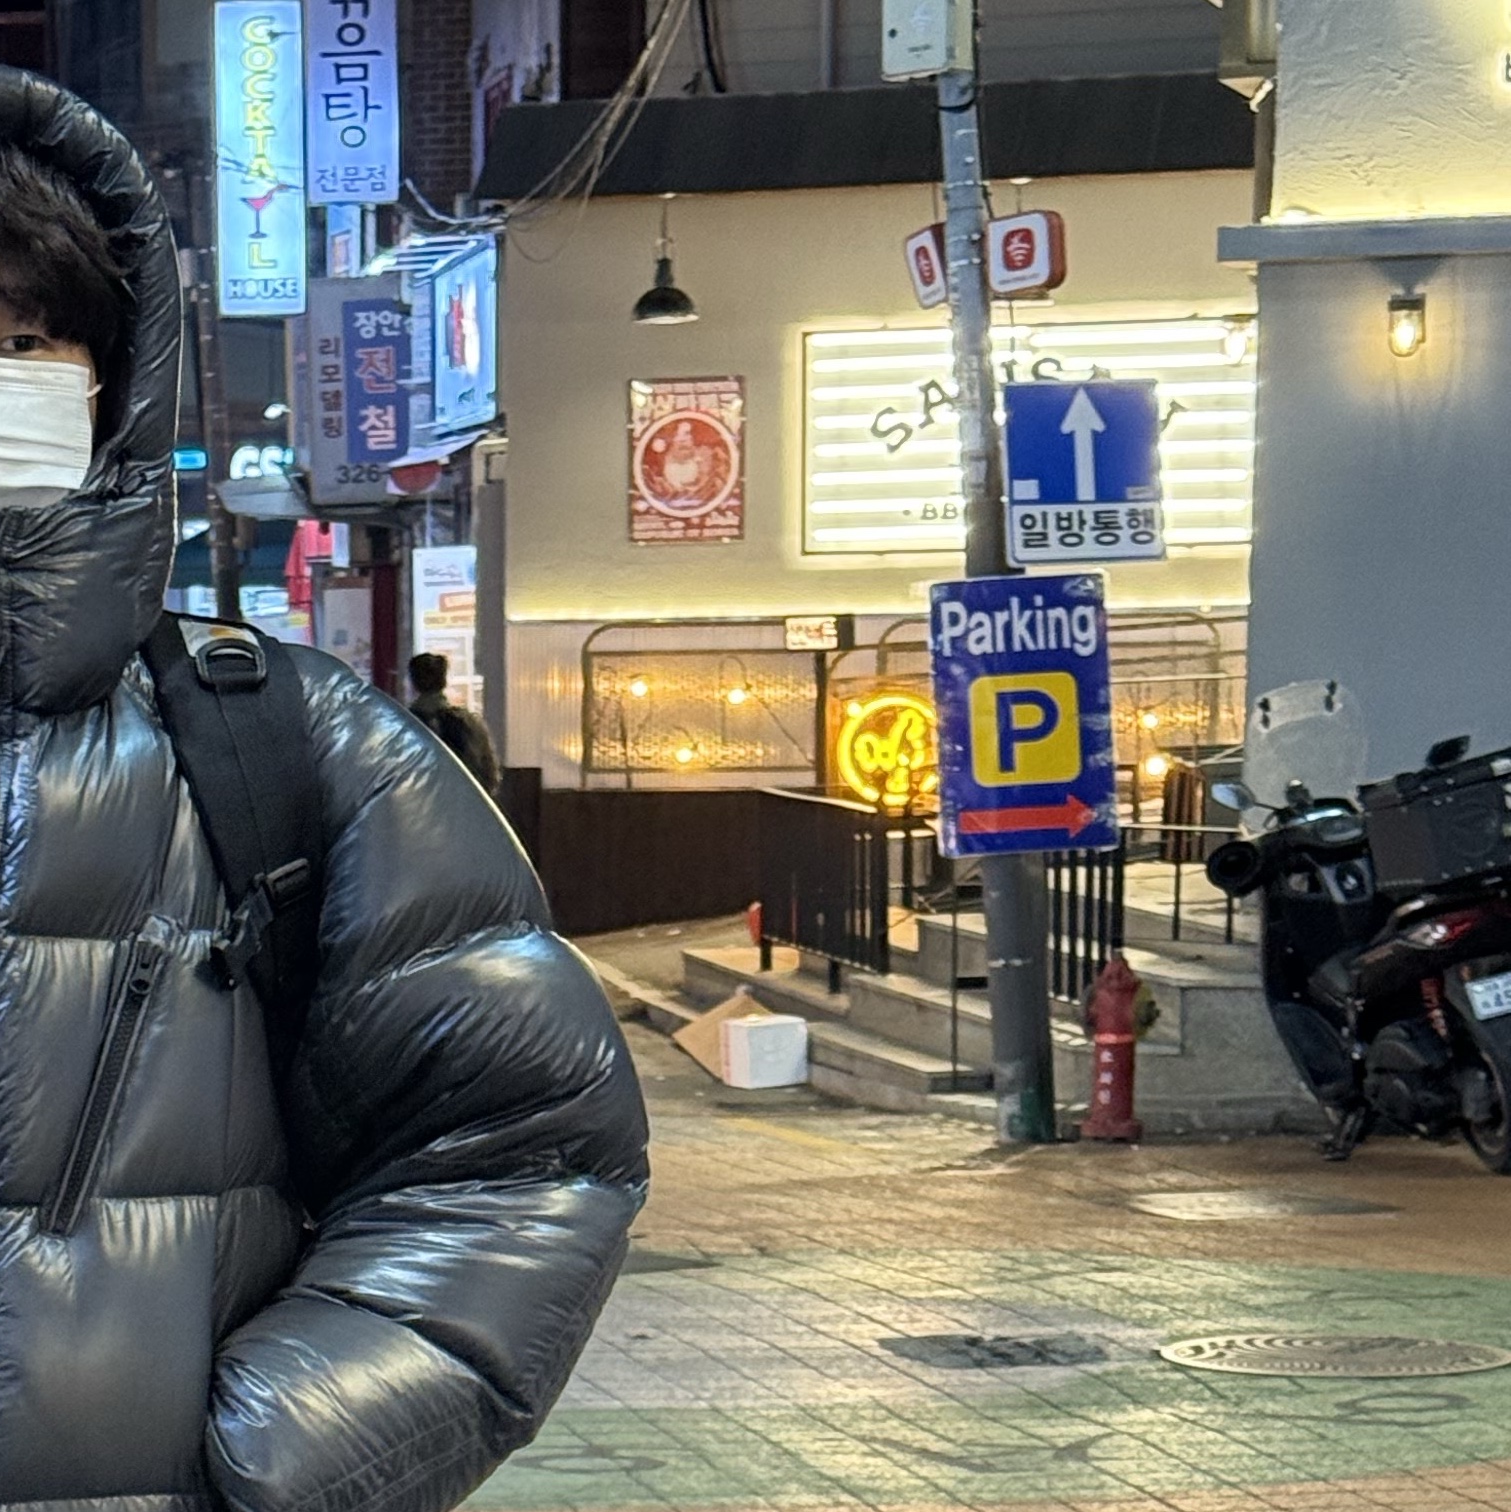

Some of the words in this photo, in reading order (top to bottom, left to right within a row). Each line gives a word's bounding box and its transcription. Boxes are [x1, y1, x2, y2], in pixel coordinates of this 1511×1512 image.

[315, 165, 388, 193] 전문점
[227, 277, 299, 299] HOUSE
[317, 338, 344, 439] 리모델링
[354, 346, 399, 450] 전철
[1019, 508, 1156, 549] 일방통행
[940, 594, 1098, 657] Parking
[996, 690, 1059, 773] P
